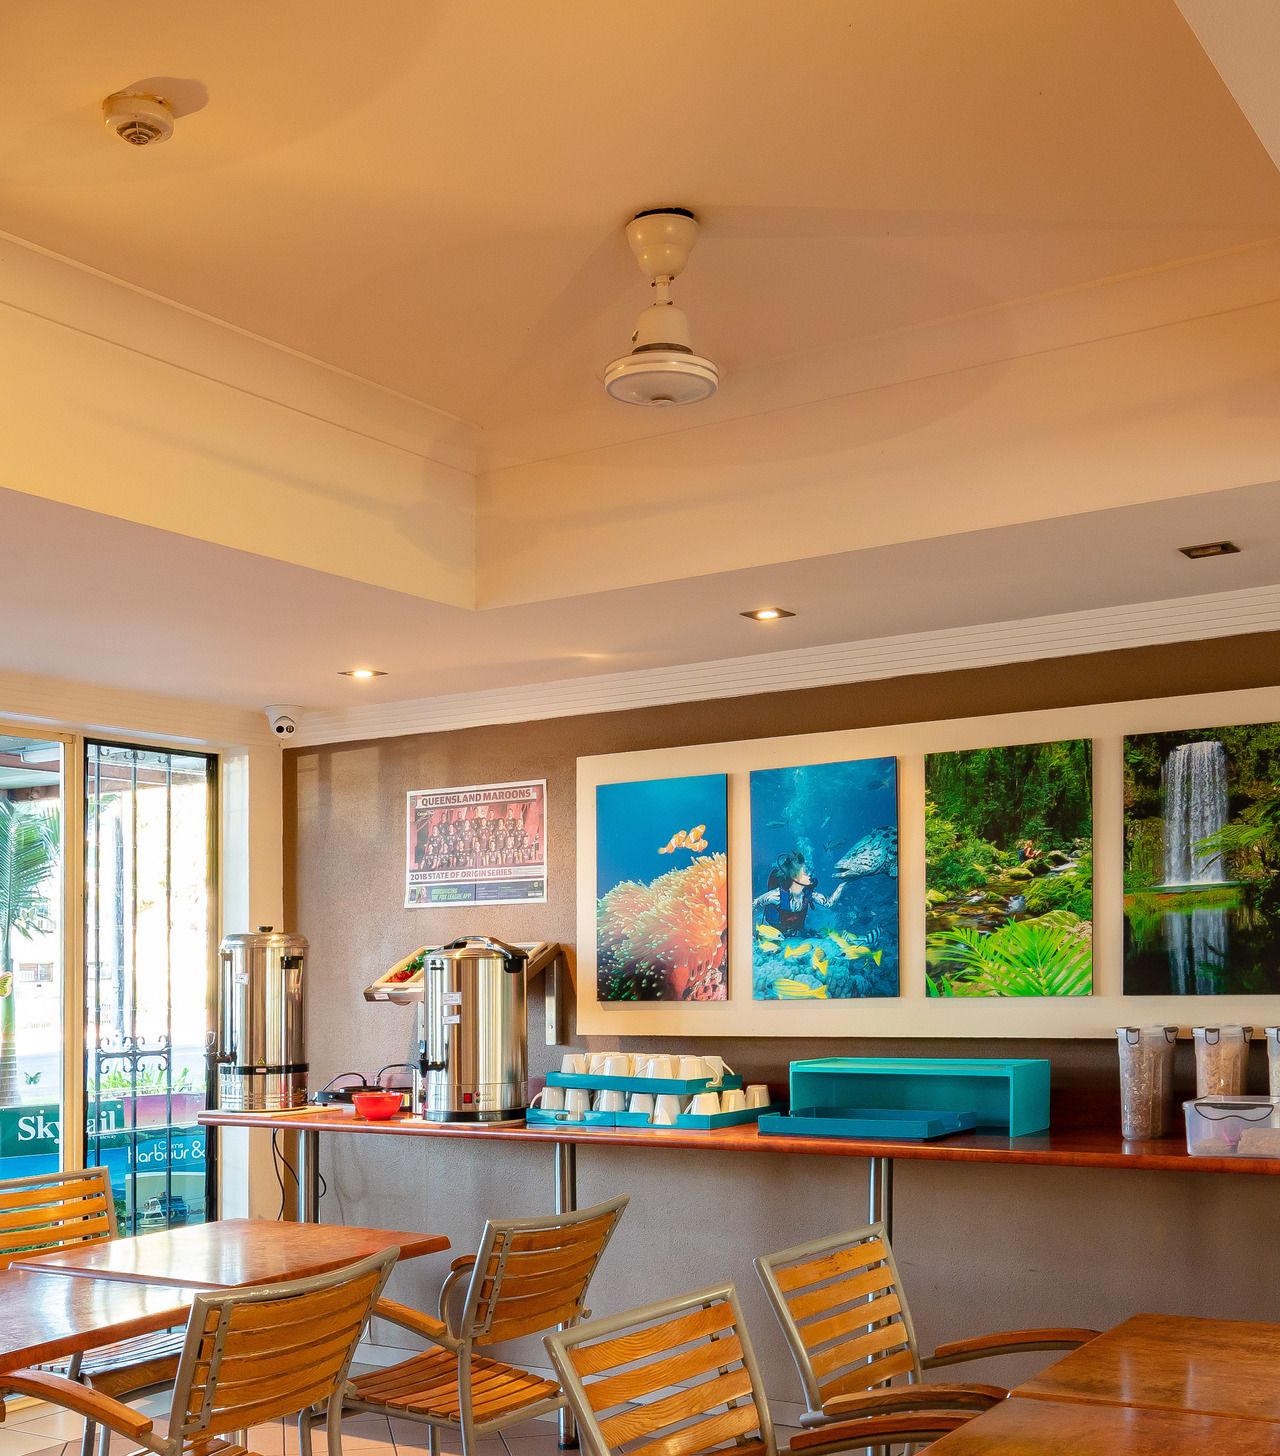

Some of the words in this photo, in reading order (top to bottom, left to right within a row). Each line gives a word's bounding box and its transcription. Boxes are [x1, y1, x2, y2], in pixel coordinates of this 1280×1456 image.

[421, 793, 481, 806] QUEENSLAND
[483, 789, 531, 800] MAROONS
[410, 872, 427, 880] 2018
[428, 872, 449, 880] STATE
[450, 871, 459, 879] OF
[461, 870, 486, 878] ORIGIN
[487, 869, 512, 877] SERIES
